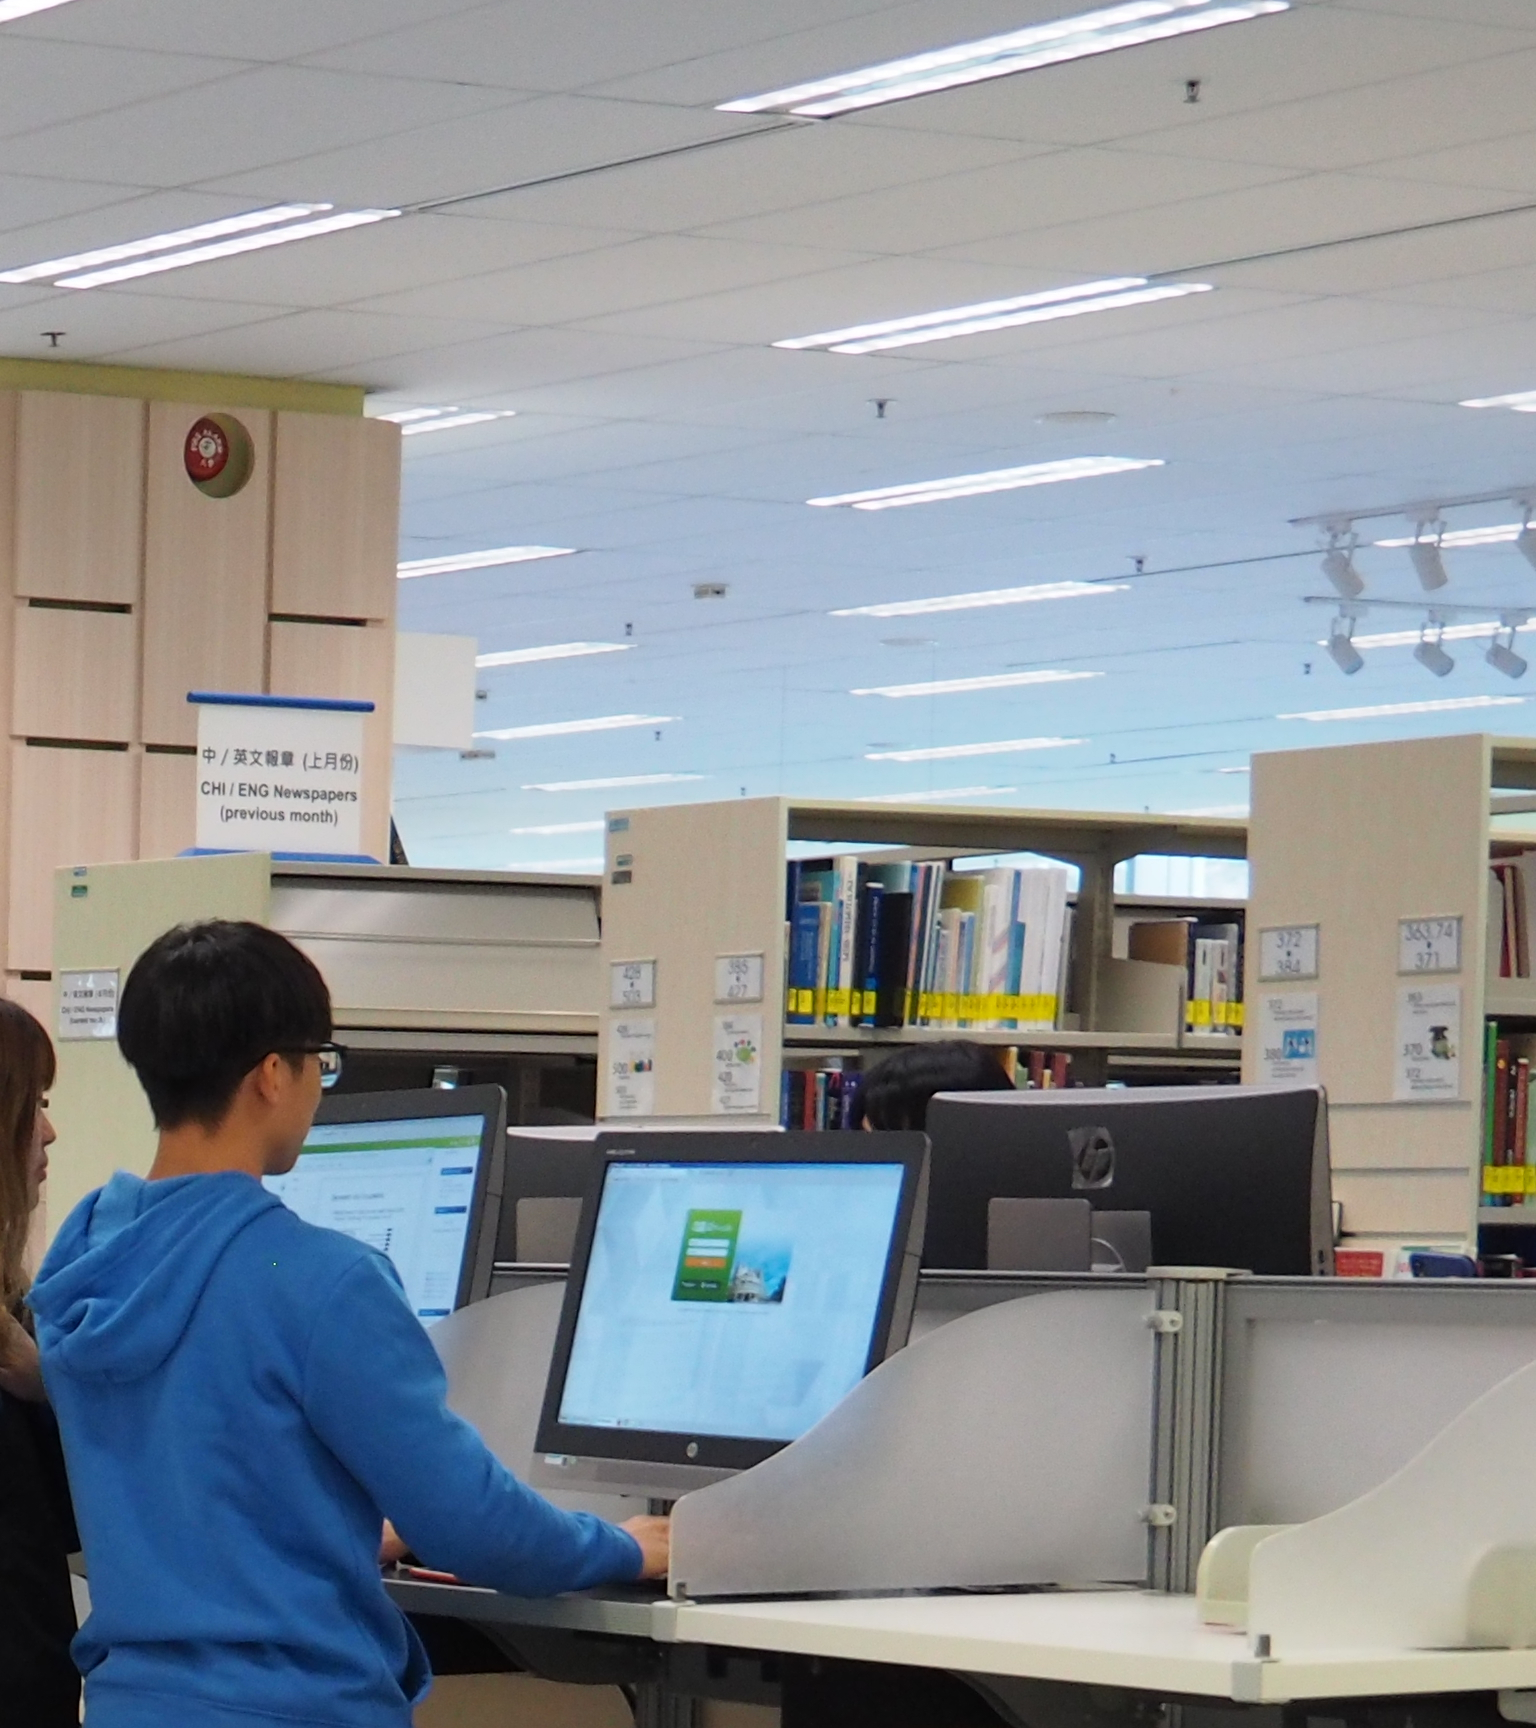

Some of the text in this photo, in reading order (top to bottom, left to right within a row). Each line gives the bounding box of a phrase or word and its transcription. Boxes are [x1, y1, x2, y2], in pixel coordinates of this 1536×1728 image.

[202, 747, 359, 774] 中 / 英文報章 (上月份)
[201, 781, 358, 804] CHI / ENG Newspapers
[220, 805, 339, 827] (previous month)
[1277, 931, 1302, 949] 372
[1414, 952, 1440, 970] 371
